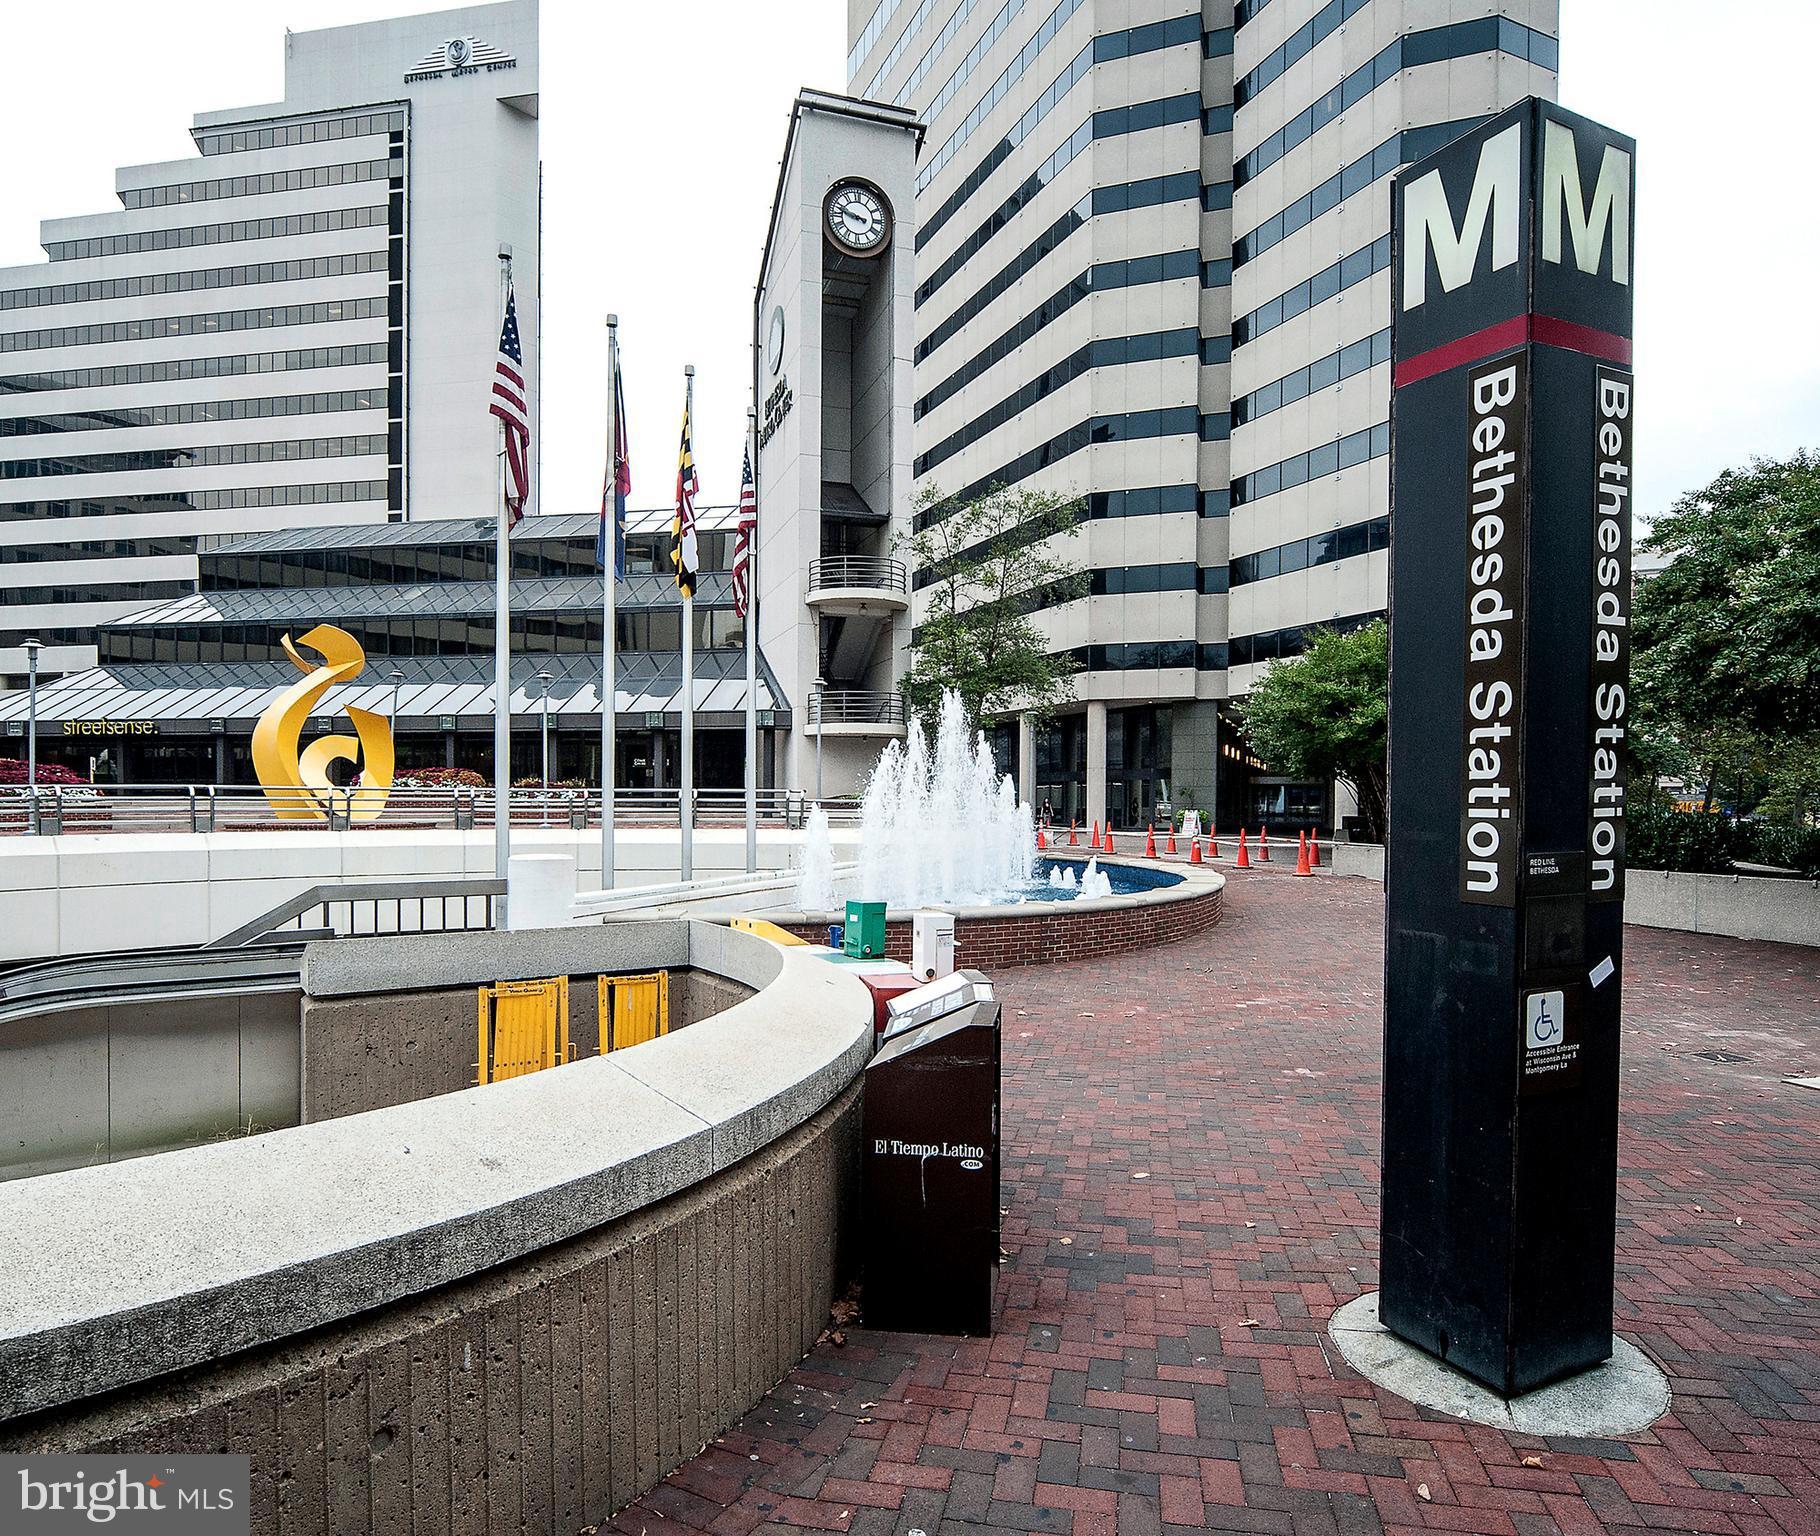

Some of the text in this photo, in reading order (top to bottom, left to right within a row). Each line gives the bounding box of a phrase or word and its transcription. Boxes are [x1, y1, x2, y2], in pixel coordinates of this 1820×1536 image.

[1542, 118, 1631, 286] M
[1403, 121, 1521, 312] M
[1466, 365, 1517, 893] Bethesda Station
[1591, 378, 1630, 890] Bethesda Station
[1530, 857, 1555, 866] RED LINE
[1530, 866, 1559, 875] BETHESDA
[1525, 1043, 1580, 1058] Accessible Entrance
[1525, 1059, 1532, 1067] at
[1533, 1054, 1561, 1065] Wisconsin
[1525, 1061, 1568, 1075] Montgomery La
[875, 1139, 984, 1158] El Tiempo Latino
